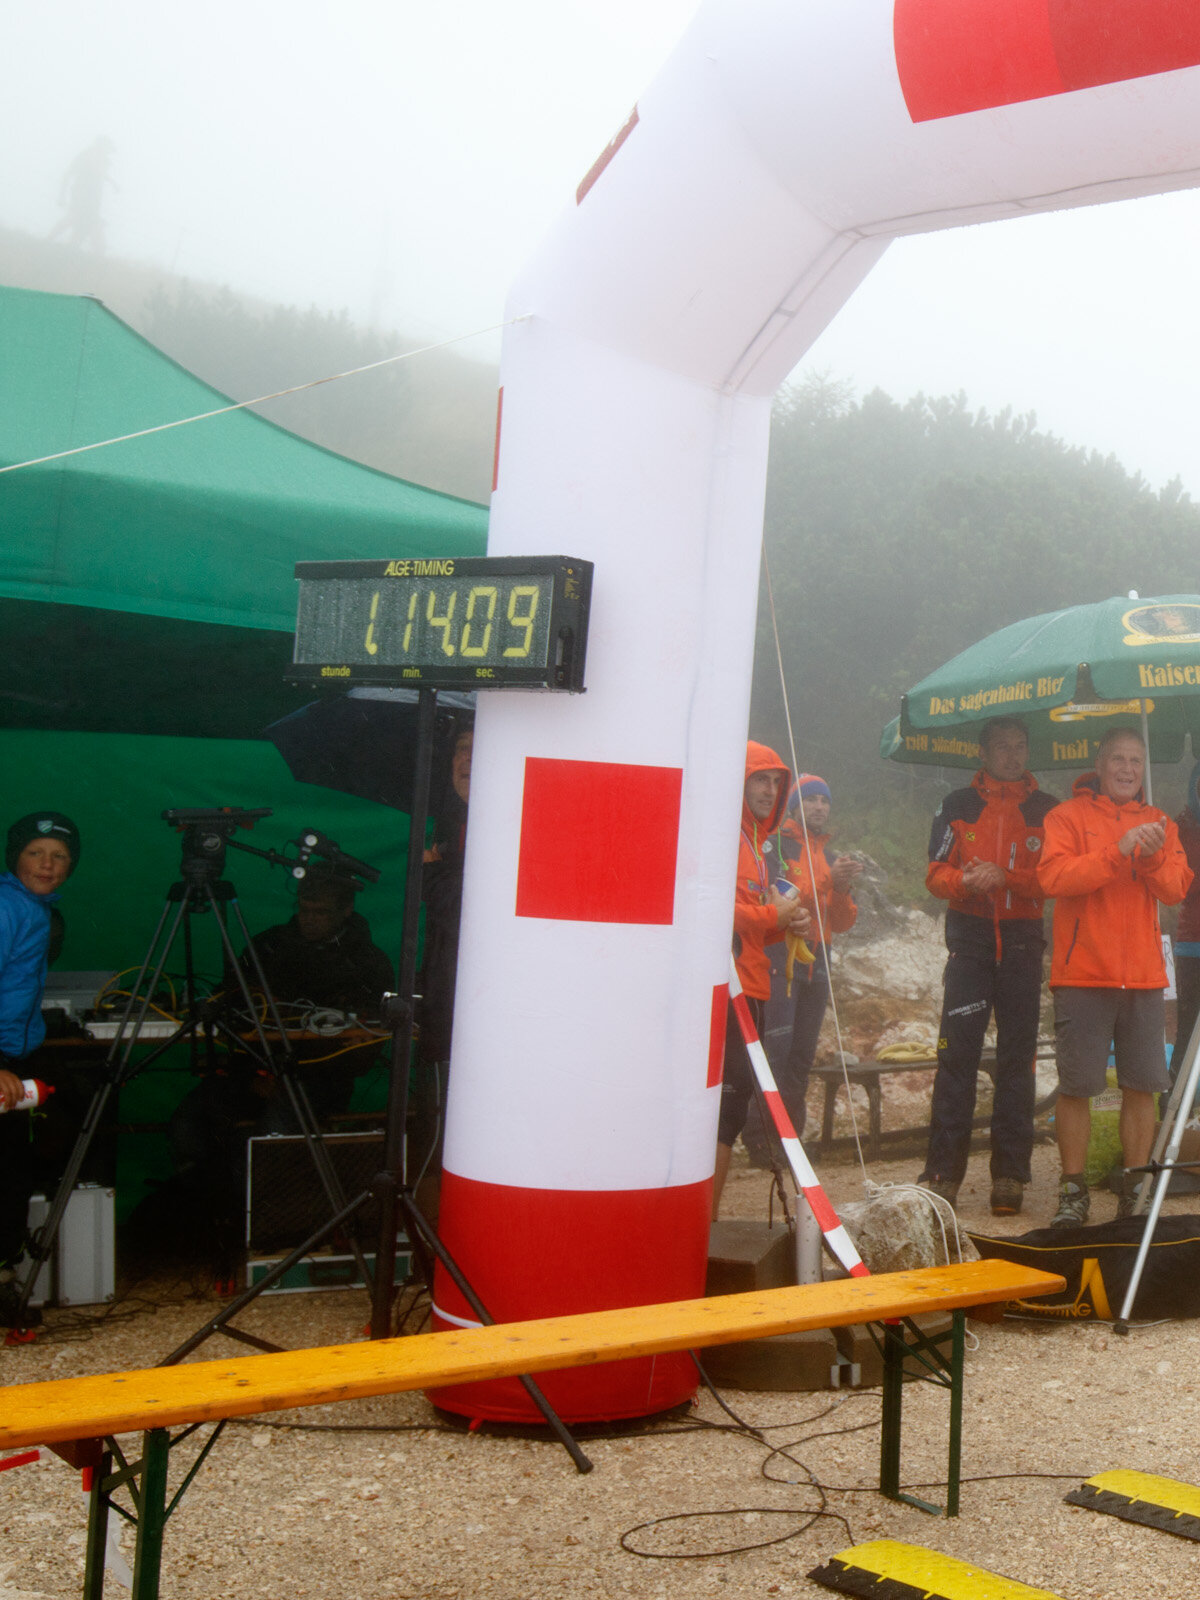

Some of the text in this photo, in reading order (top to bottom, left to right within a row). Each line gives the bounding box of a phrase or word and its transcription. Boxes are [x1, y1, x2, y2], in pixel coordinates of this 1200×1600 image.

[384, 559, 455, 576] ALGE-TIMING
[321, 666, 495, 679] stunde min. sec.
[929, 697, 955, 716] Das
[1036, 676, 1065, 698] Bier
